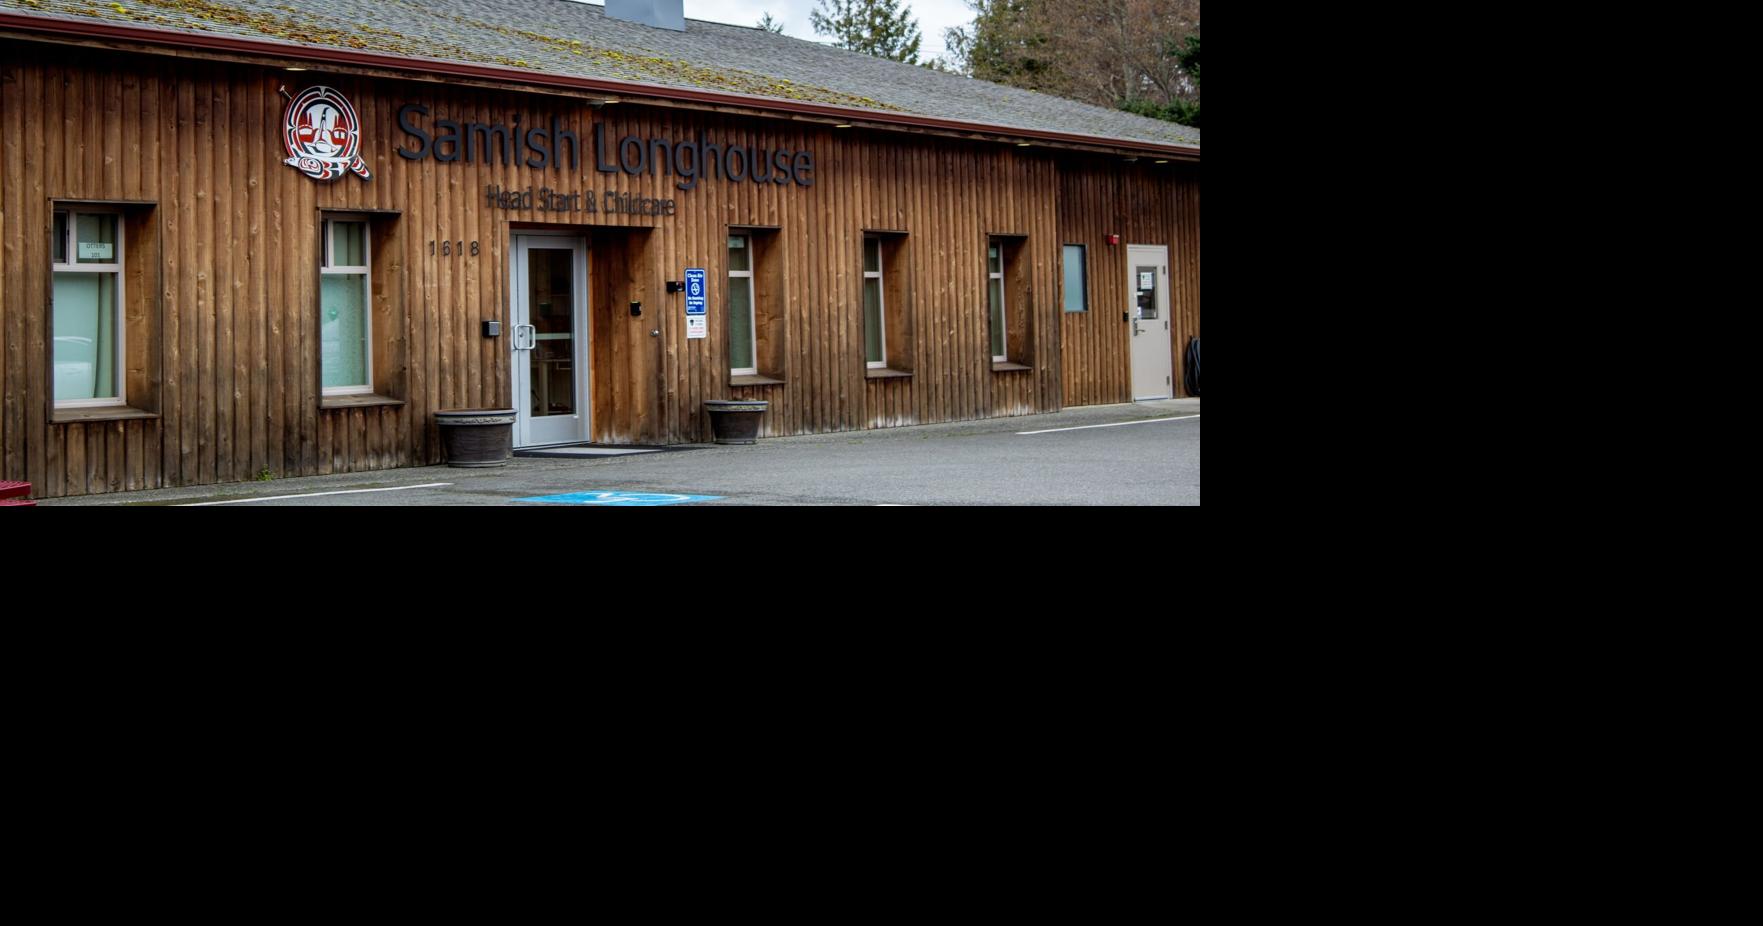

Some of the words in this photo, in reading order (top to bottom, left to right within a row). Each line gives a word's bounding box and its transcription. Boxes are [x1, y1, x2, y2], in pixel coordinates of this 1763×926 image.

[397, 104, 578, 171] Samish
[596, 122, 814, 190] Longhouse
[486, 184, 532, 210] Head
[537, 186, 581, 212] Start
[586, 190, 597, 213] &
[603, 191, 676, 216] Childcare
[429, 240, 480, 256] 1618
